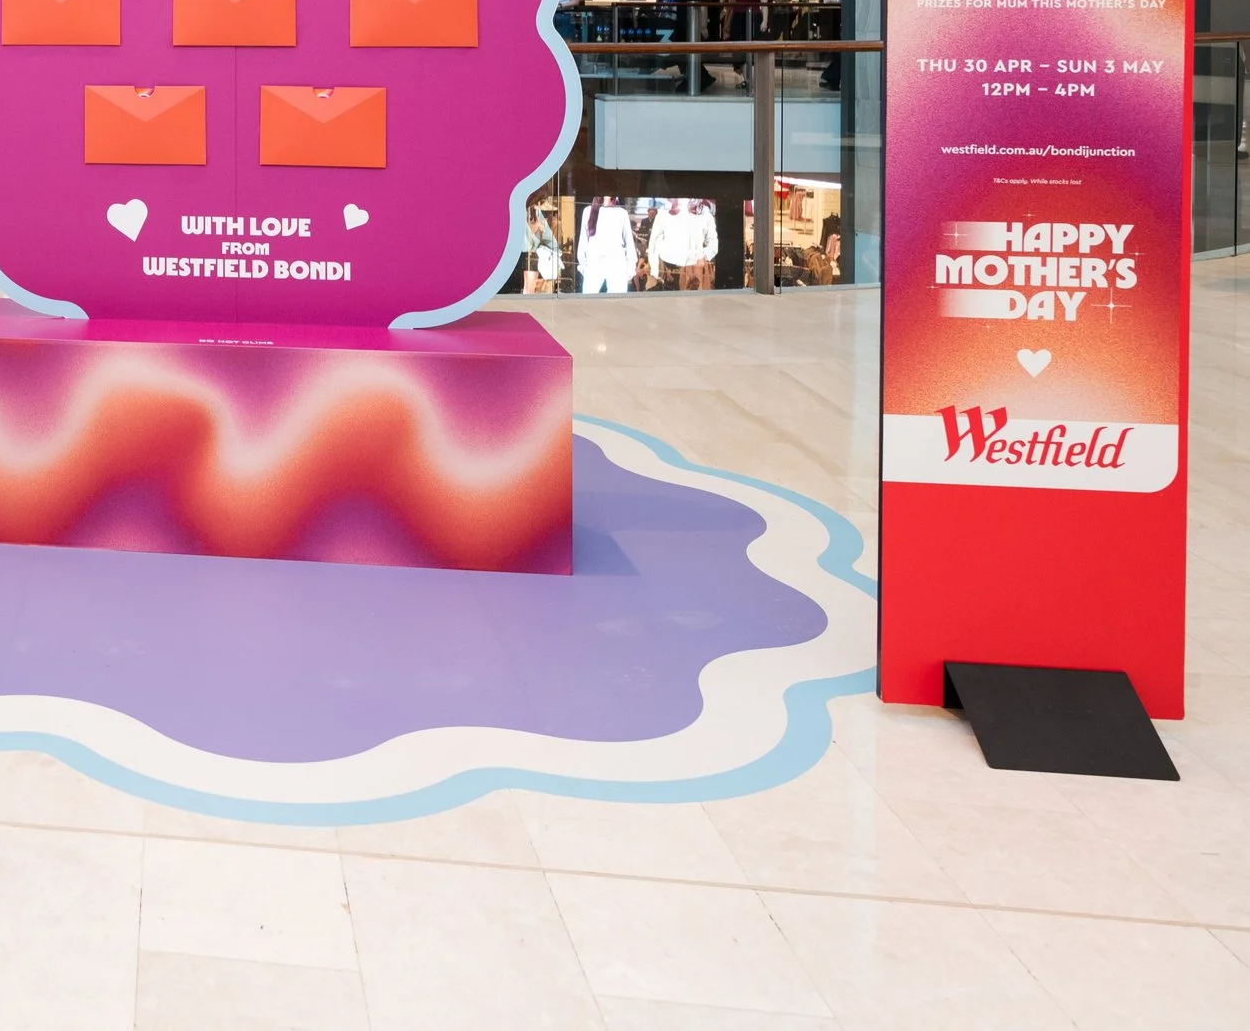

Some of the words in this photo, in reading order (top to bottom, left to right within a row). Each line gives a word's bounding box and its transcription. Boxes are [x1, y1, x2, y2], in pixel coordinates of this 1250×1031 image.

[917, 59, 957, 72] THU
[964, 59, 988, 72] 30
[994, 59, 1032, 72] APR
[1057, 60, 1097, 73] SUN
[1104, 60, 1115, 73] 3
[1123, 61, 1164, 73] MAY
[982, 83, 1030, 96] 12PM
[1055, 84, 1095, 96] 4PM
[941, 144, 1135, 158] westfield.com.au/bondijunction
[181, 216, 244, 236] WITH
[249, 217, 311, 237] LOVE
[221, 242, 270, 255] FROM
[998, 222, 1135, 254] HAPPY
[142, 257, 268, 279] WESTFIELD
[273, 261, 351, 281] BONDI
[935, 254, 1138, 289] MOTHER'S
[995, 289, 1087, 321] DAY
[934, 404, 1135, 469] Westfield
